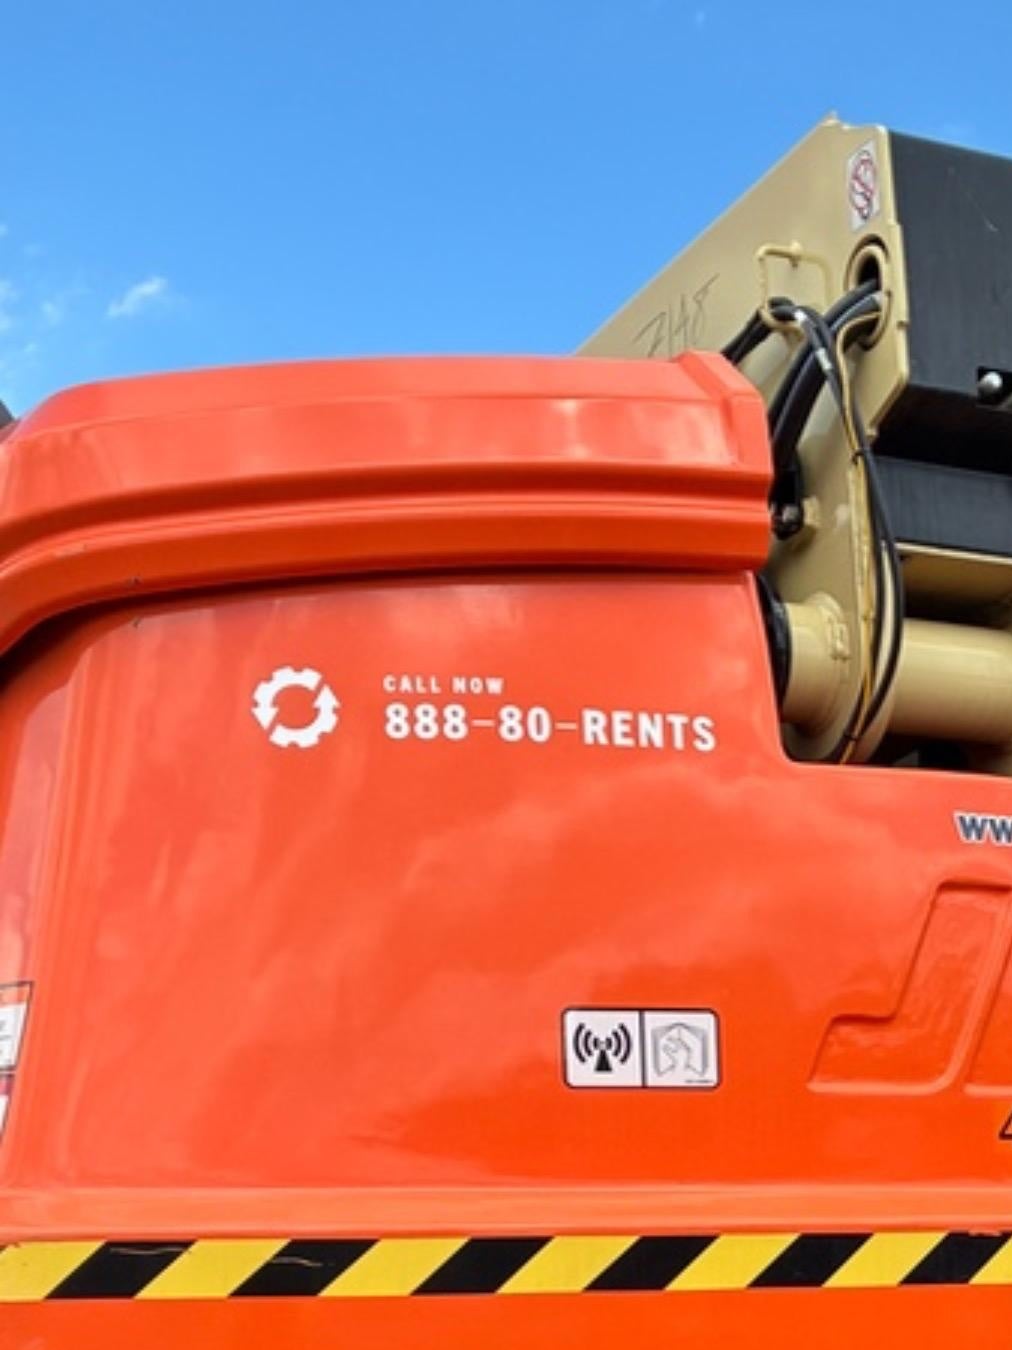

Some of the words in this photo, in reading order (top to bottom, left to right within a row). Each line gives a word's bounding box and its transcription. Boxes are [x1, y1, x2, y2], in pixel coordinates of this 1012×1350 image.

[383, 674, 442, 694] CALL
[452, 676, 505, 695] NOW
[384, 702, 717, 752] 888-80-RENTS
